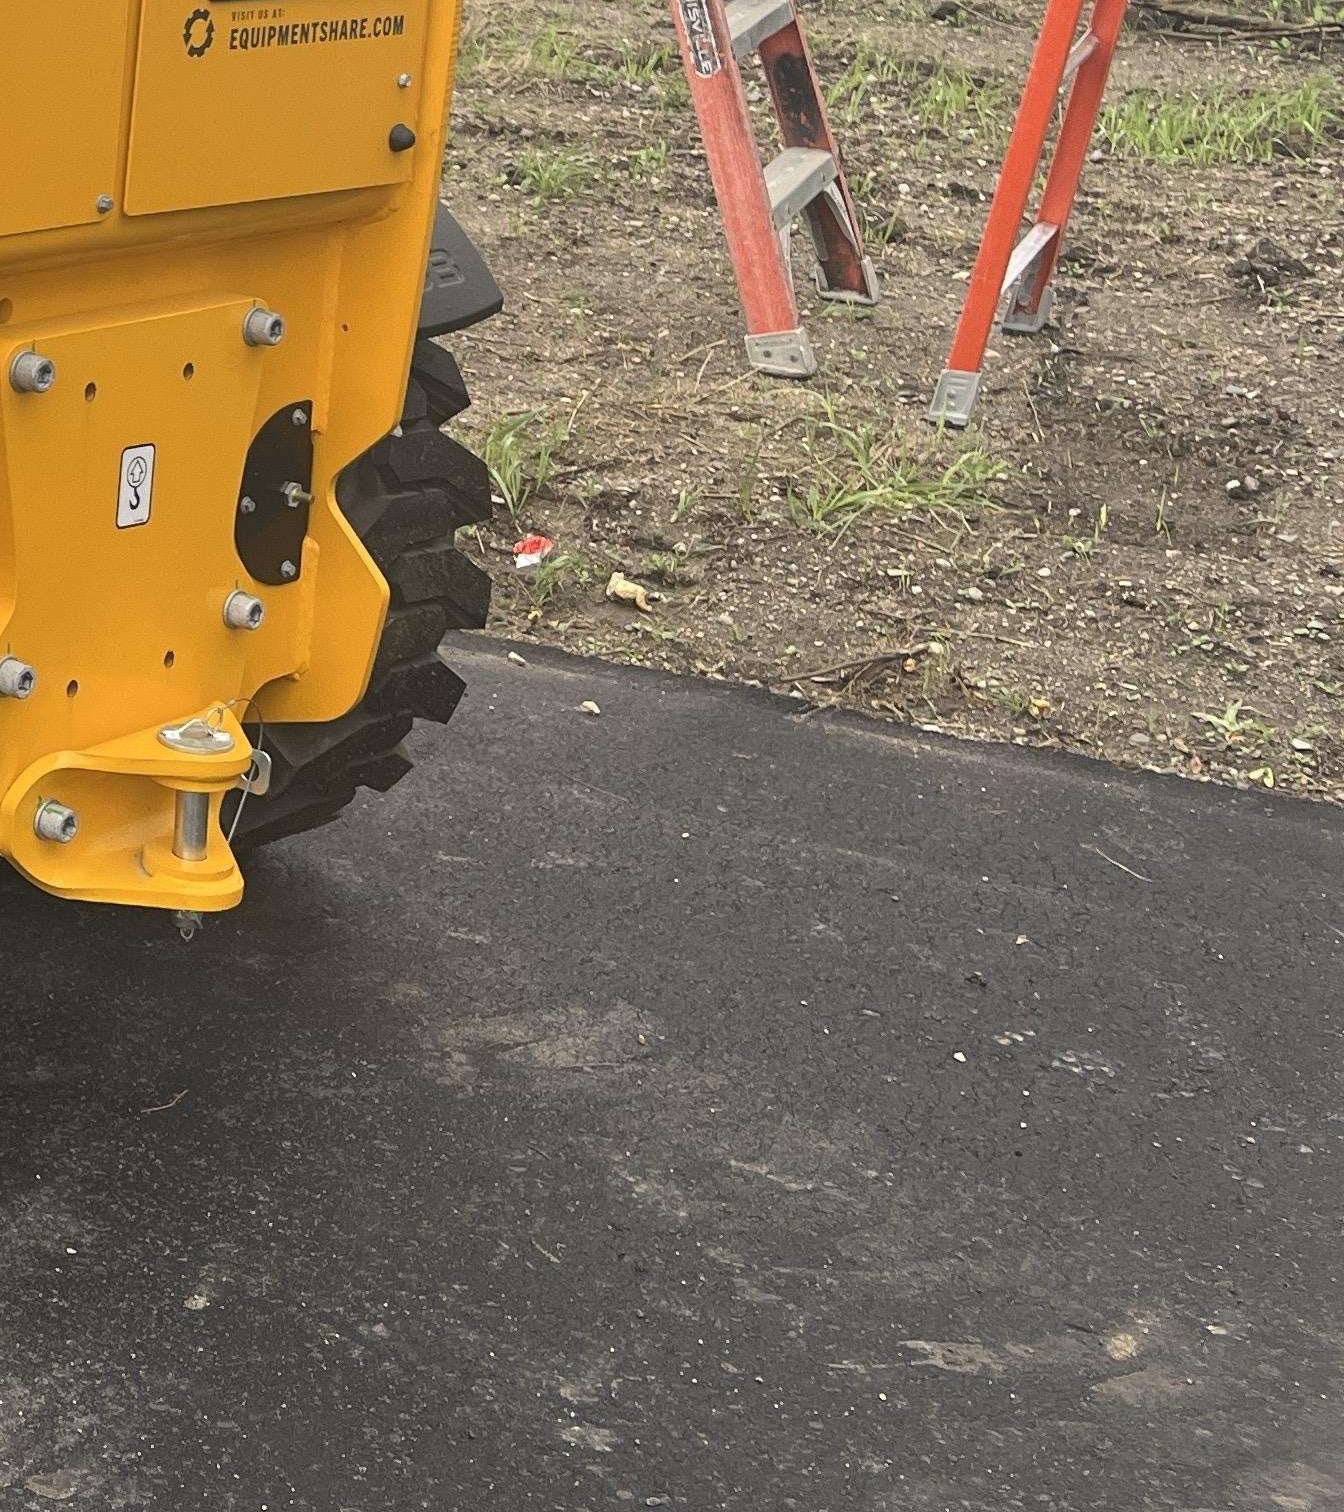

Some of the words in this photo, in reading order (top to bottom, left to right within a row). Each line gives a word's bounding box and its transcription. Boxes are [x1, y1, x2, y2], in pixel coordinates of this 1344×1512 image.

[231, 9, 255, 21] VISIT
[258, 9, 270, 20] US
[229, 14, 405, 51] EQUIPMENTSHARE.COM
